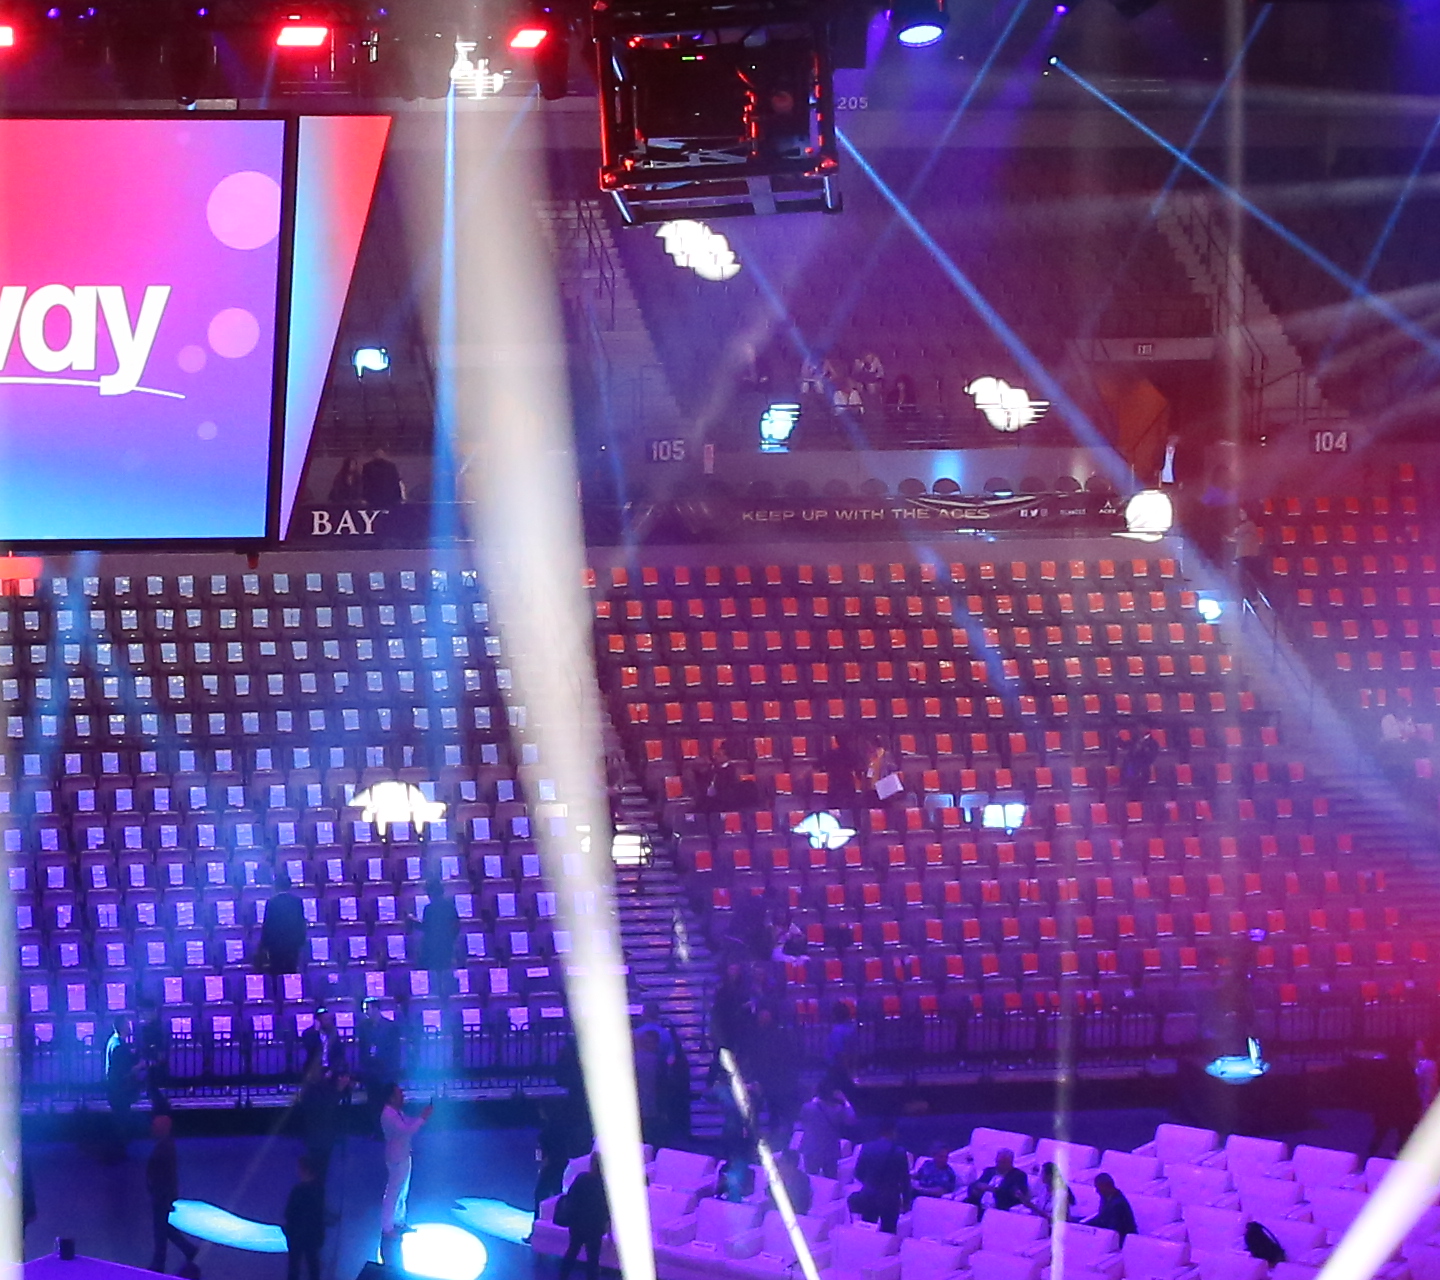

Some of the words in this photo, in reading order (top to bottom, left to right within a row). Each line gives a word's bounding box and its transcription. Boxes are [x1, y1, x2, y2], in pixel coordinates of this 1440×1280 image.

[837, 96, 868, 109] 205
[652, 440, 685, 461] 105
[1315, 431, 1347, 452] 104
[311, 509, 381, 535] BAY
[743, 509, 794, 521] KEEP
[802, 509, 829, 521] UP
[835, 508, 884, 520] WITH
[891, 507, 929, 519] THE
